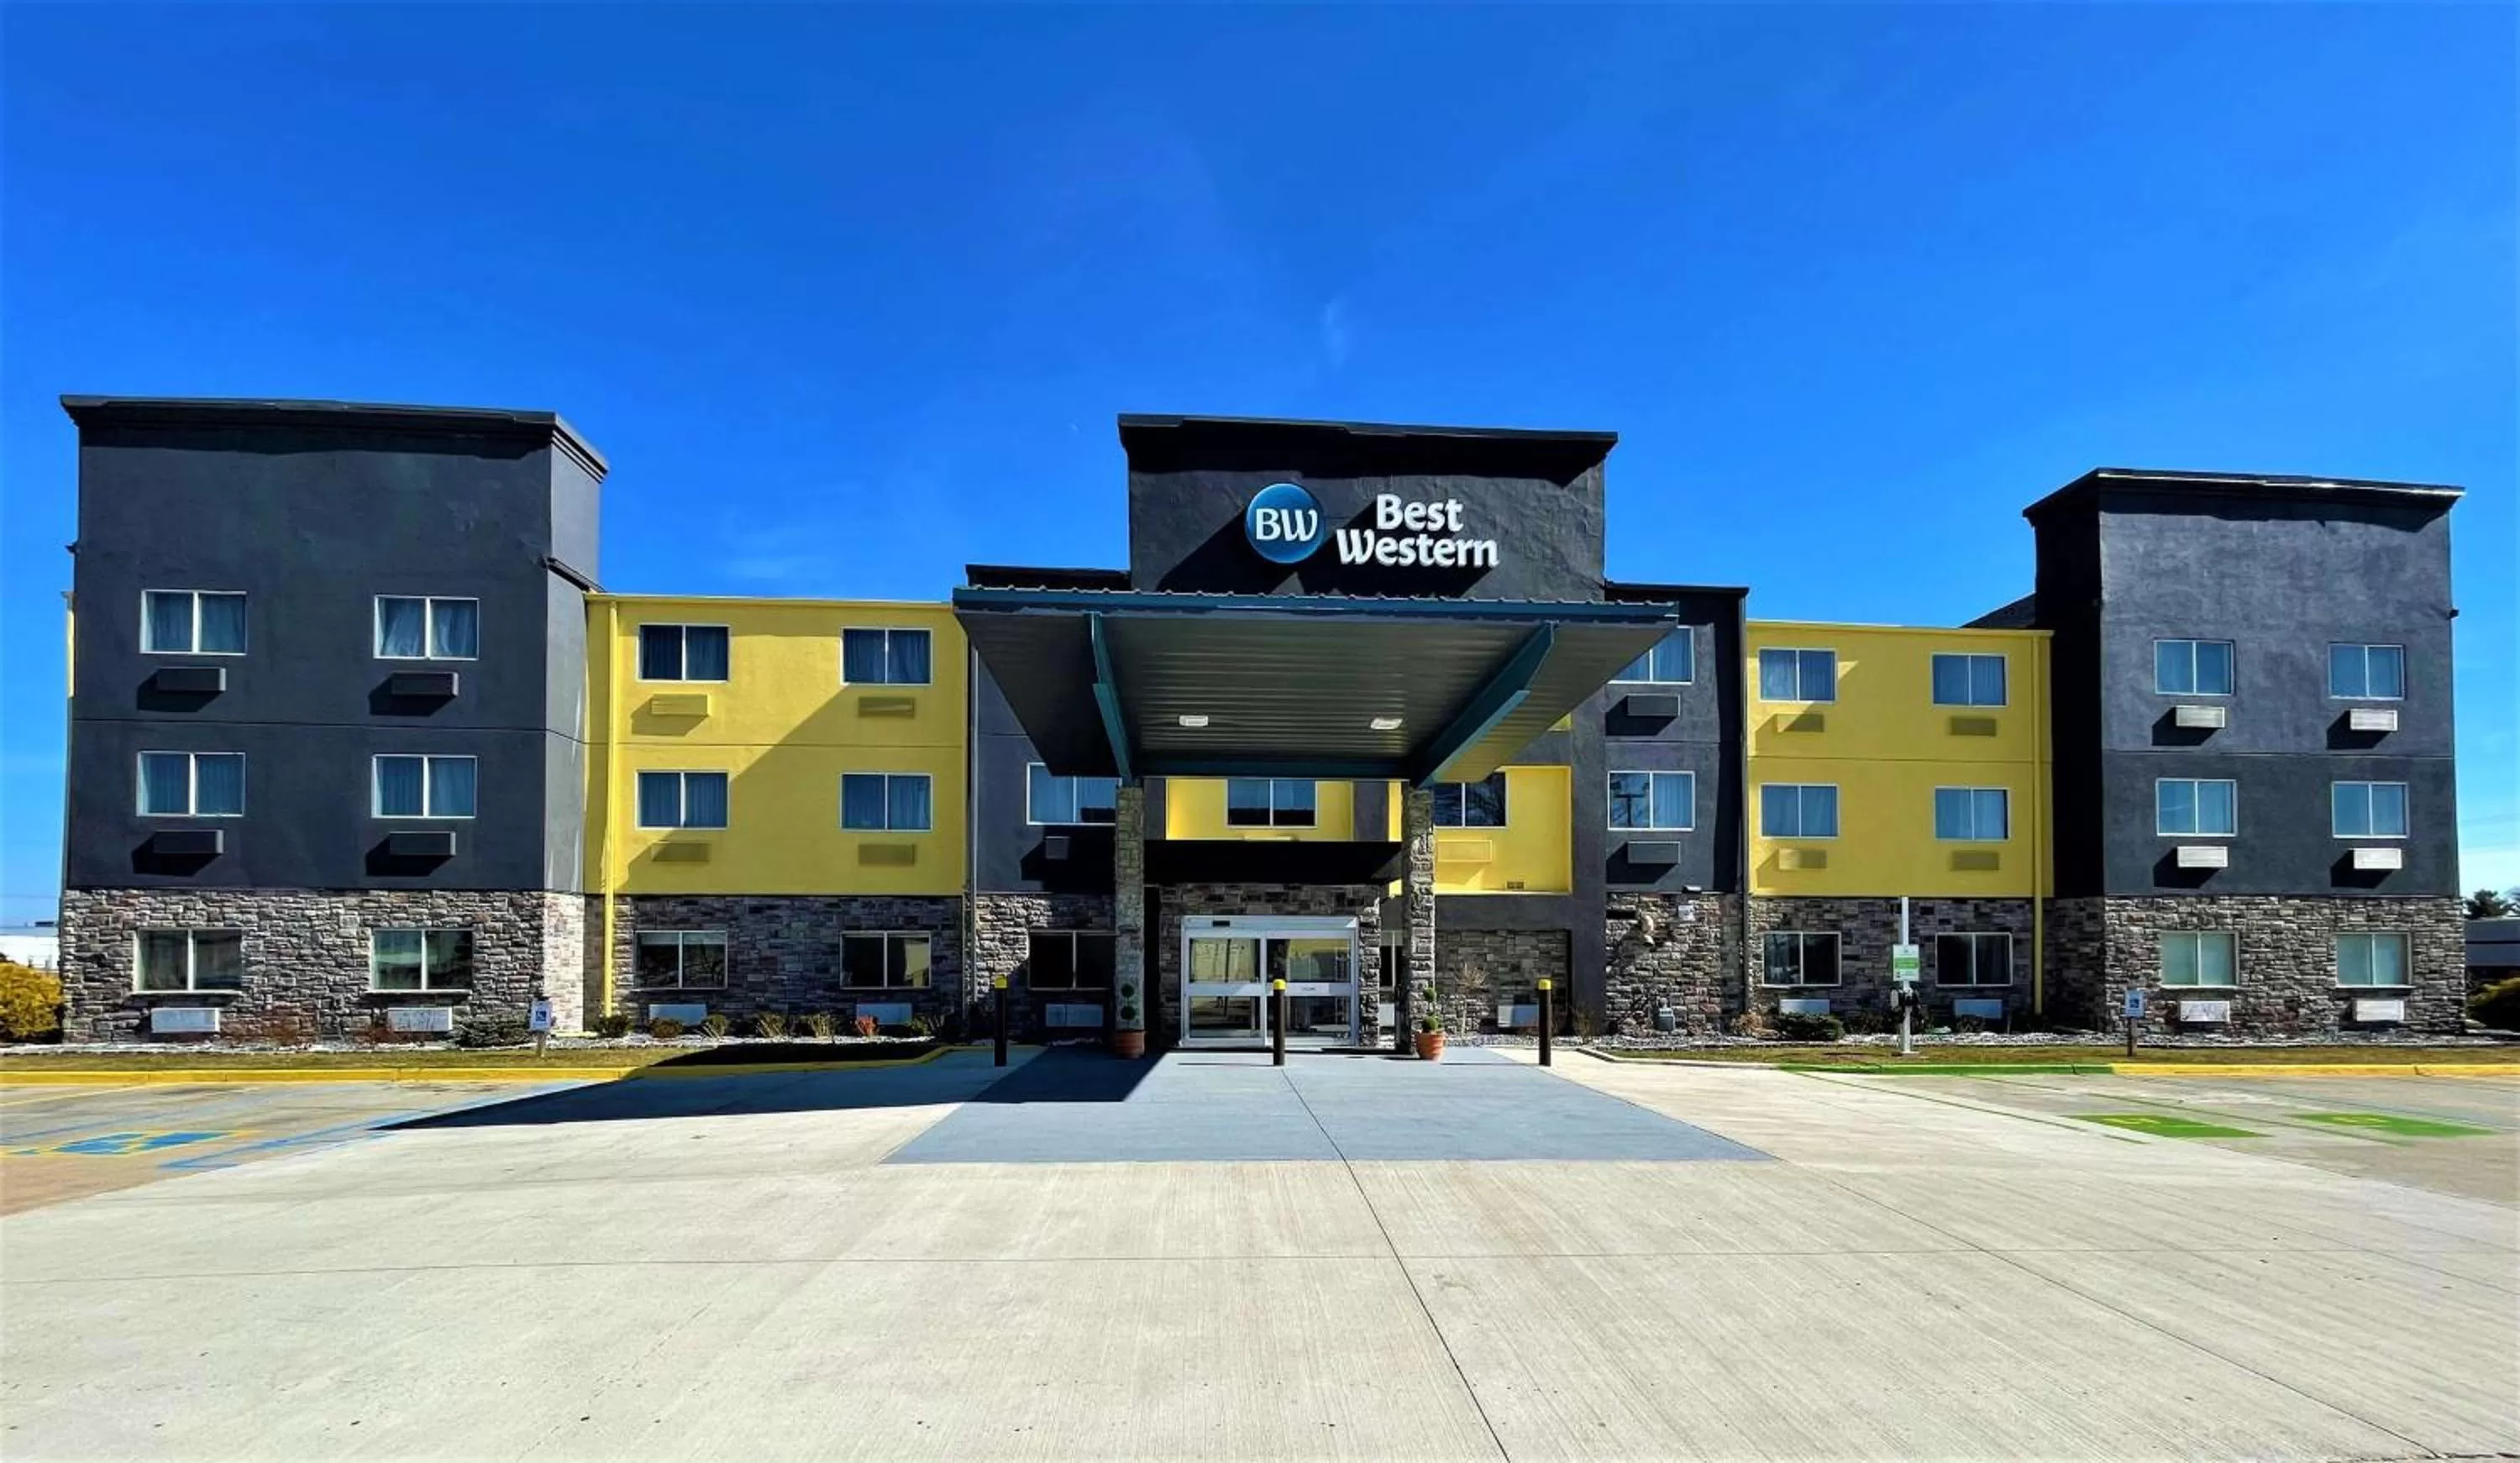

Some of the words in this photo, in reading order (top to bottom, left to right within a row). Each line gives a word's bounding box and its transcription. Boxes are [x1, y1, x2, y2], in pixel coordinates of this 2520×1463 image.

[1256, 508, 1318, 542] BW
[1376, 493, 1464, 532] Best
[1336, 528, 1500, 567] Western
